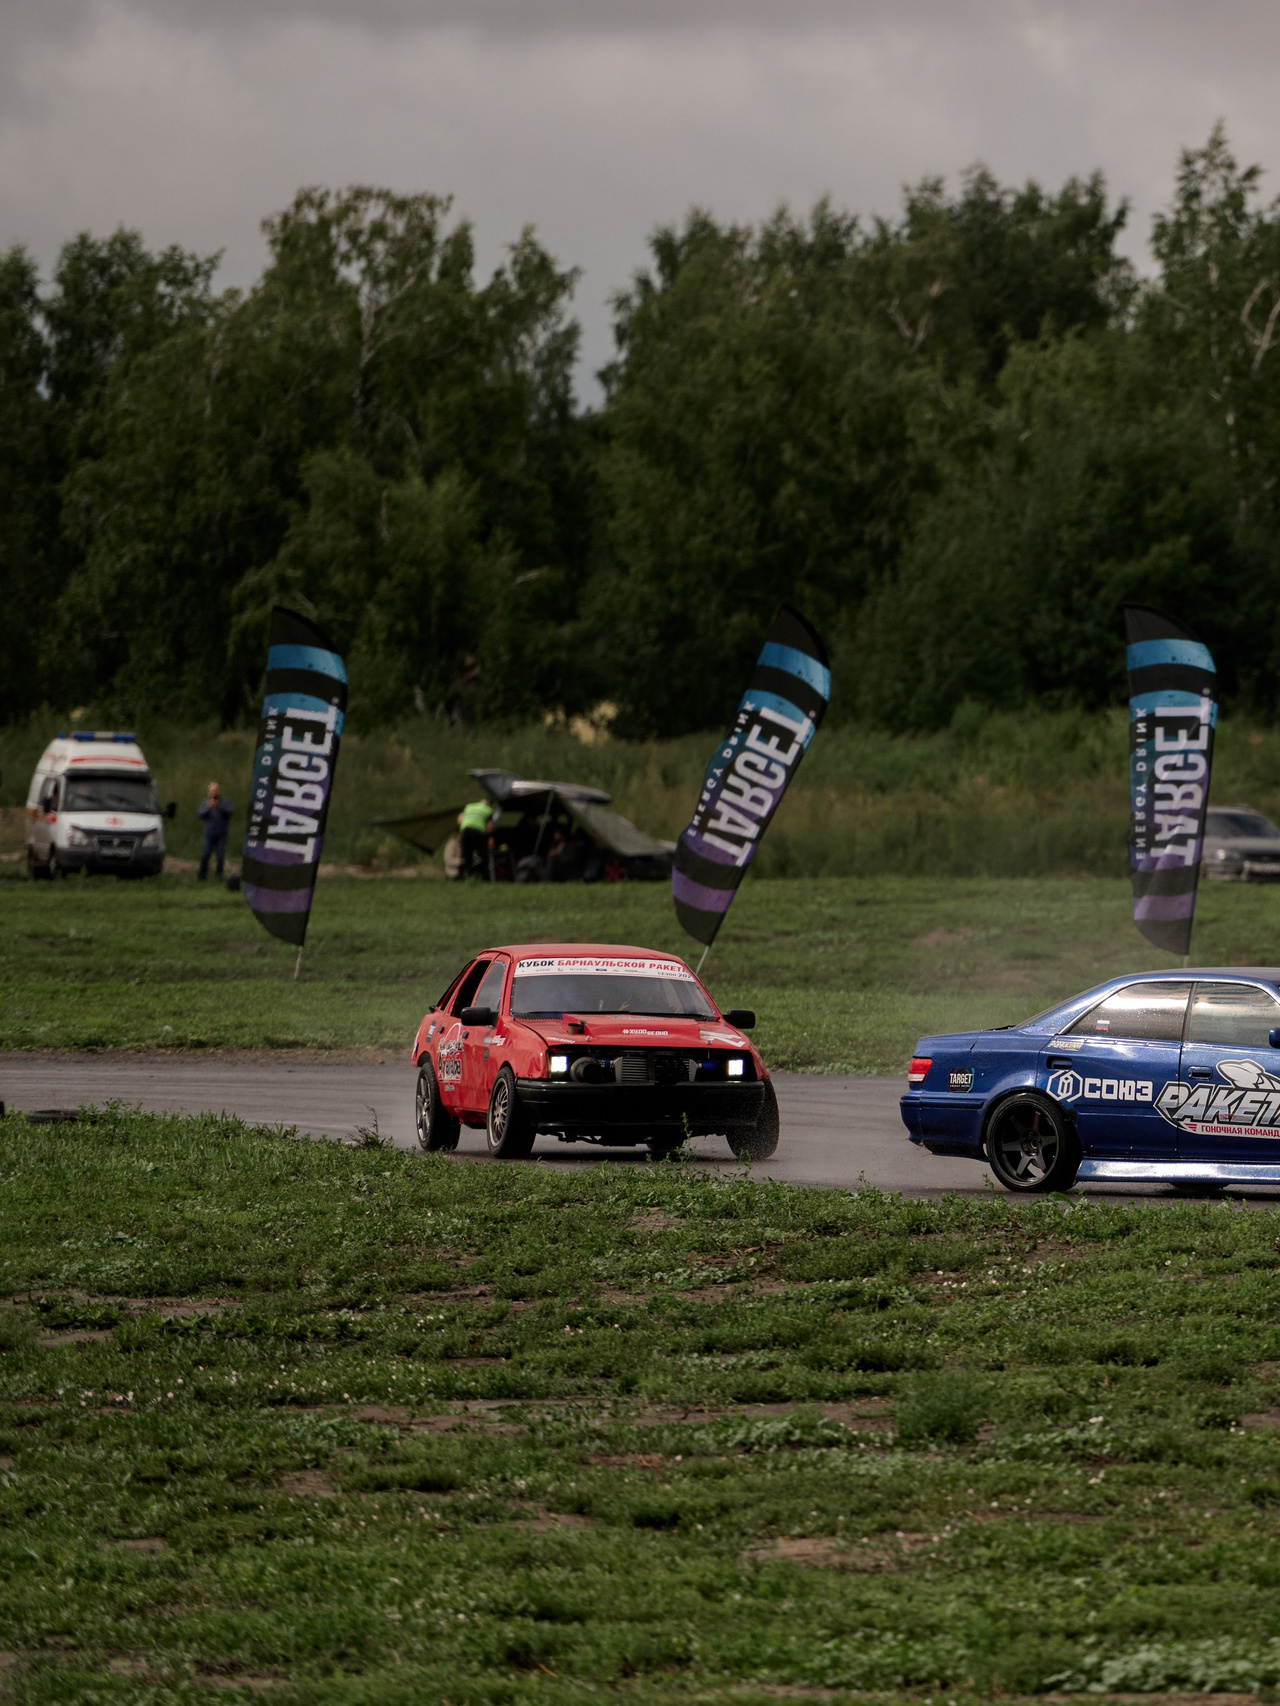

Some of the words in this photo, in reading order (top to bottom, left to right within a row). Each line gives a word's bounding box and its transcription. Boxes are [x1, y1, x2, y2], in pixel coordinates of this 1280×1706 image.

[518, 960, 555, 968] КУБОК
[557, 959, 646, 969] БАРНАУЛЬСКОЙ
[950, 1073, 973, 1084] TARGET
[1084, 1078, 1153, 1101] СОЮЗ
[1201, 1125, 1243, 1135] ГОНОЧНАЯ
